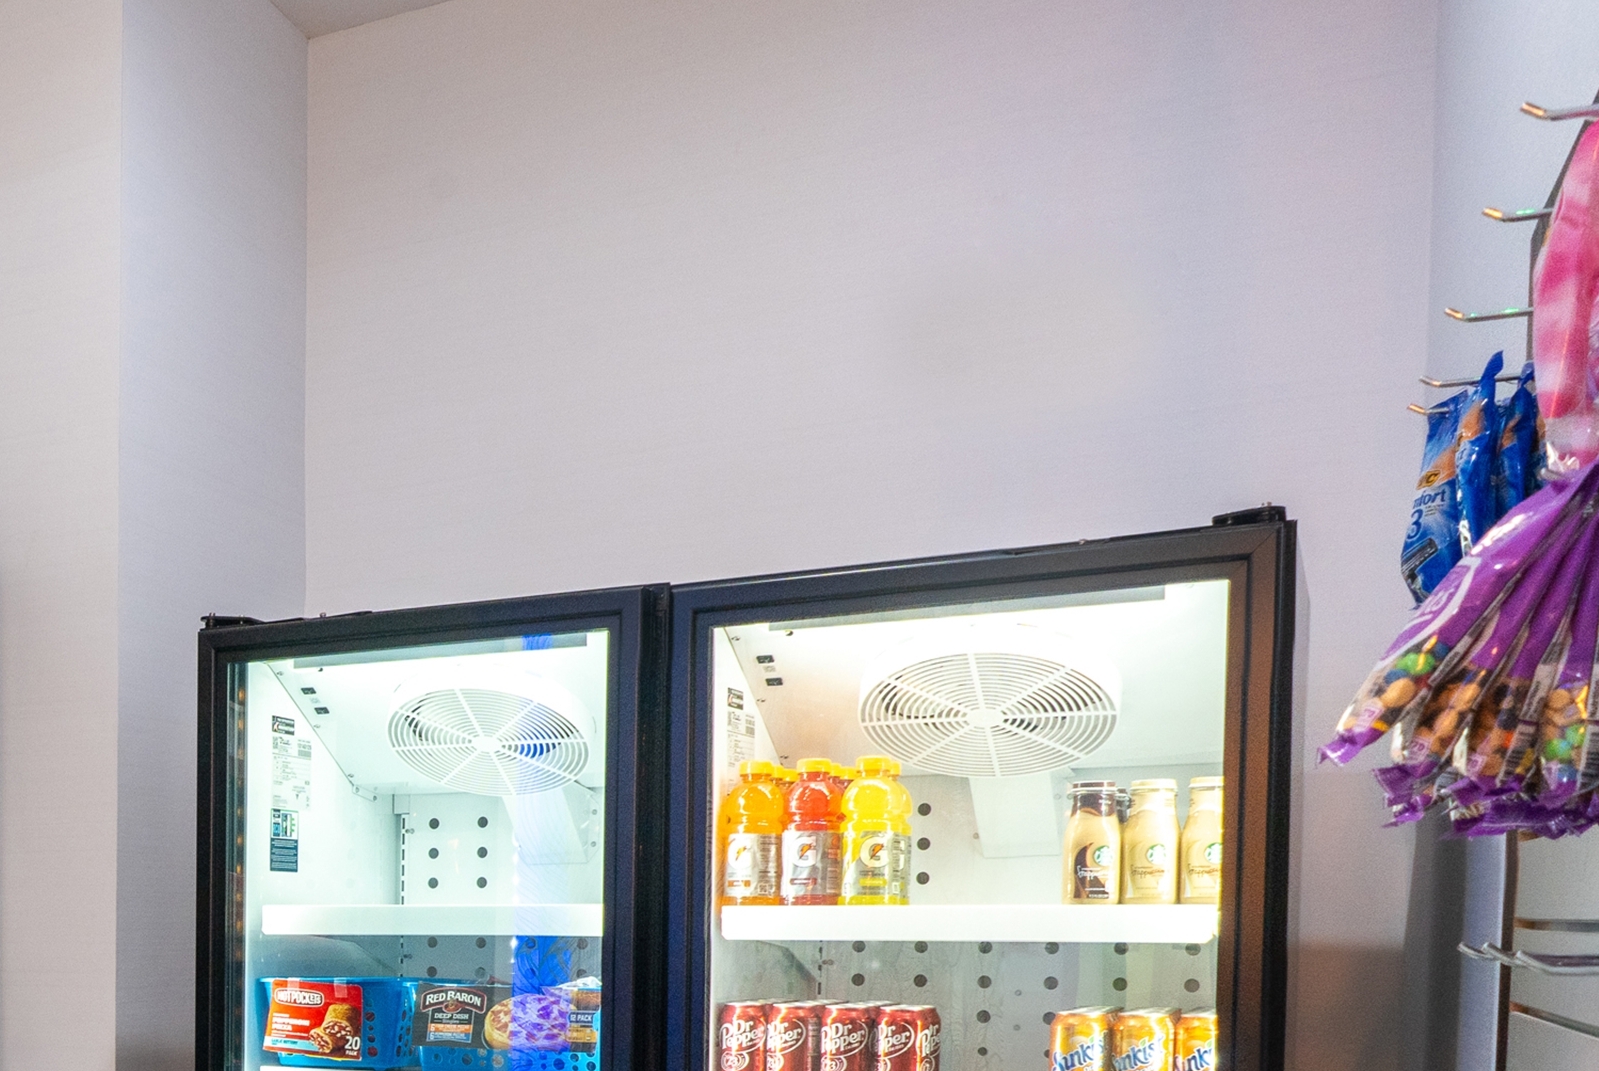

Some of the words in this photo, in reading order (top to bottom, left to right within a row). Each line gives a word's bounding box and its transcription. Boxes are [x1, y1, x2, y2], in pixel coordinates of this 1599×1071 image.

[1407, 508, 1424, 540] 3
[860, 836, 894, 868] G
[425, 992, 446, 1005] RED
[447, 990, 482, 1007] BARON
[577, 1014, 592, 1022] PACK
[733, 1019, 753, 1036] Dr
[772, 1020, 789, 1036] Dr
[833, 1023, 852, 1038] Dr
[344, 1035, 360, 1050] 20
[722, 1026, 764, 1052] Pepper
